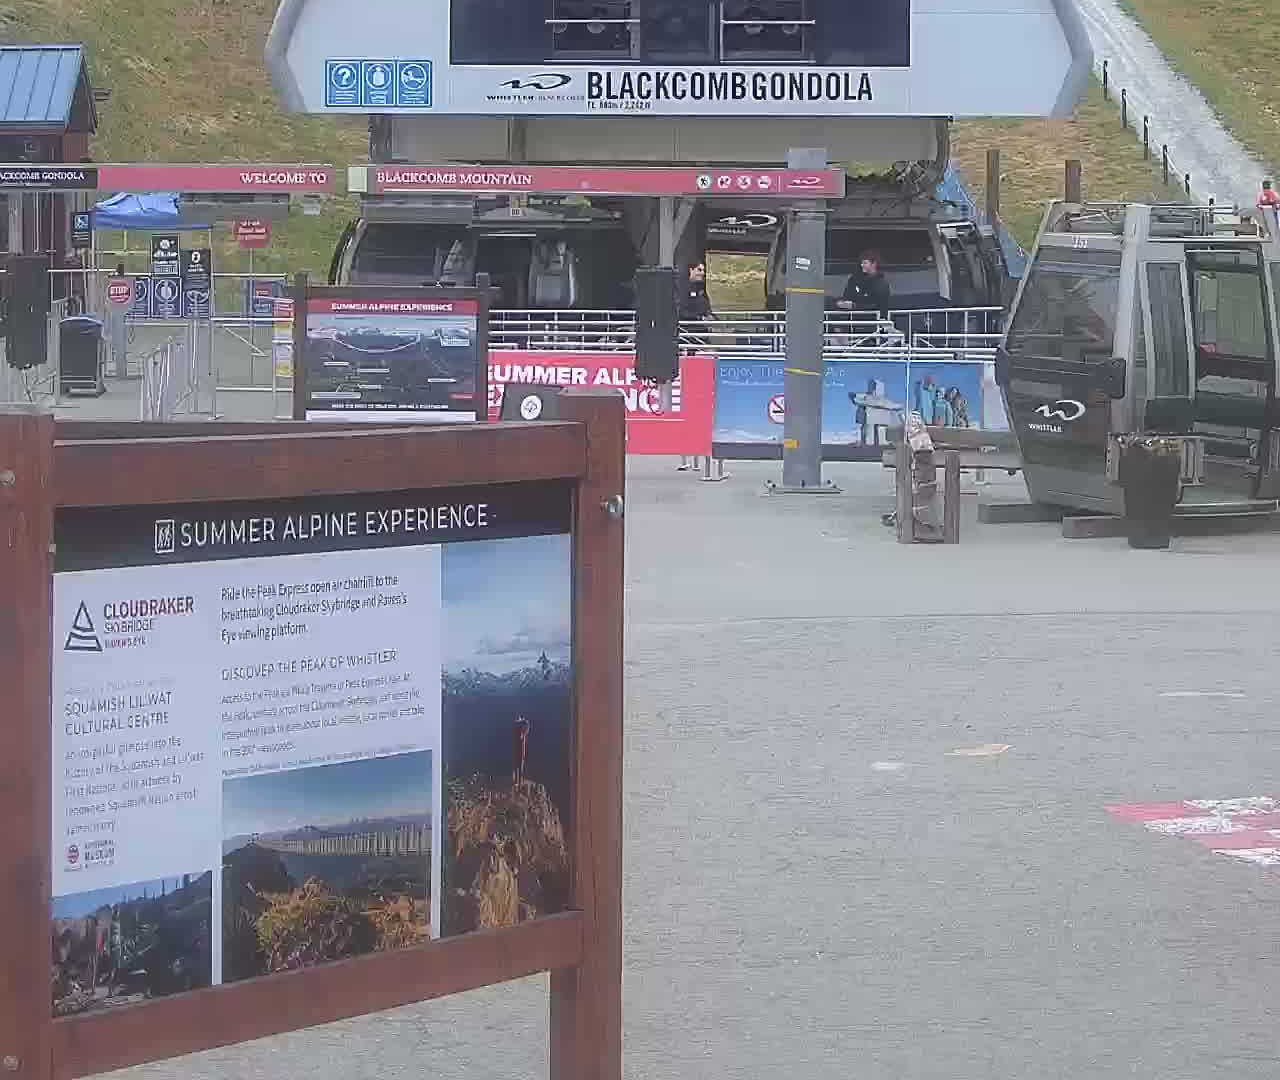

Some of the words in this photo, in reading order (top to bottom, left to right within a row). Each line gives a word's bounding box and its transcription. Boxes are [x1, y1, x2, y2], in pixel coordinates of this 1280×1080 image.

[586, 70, 747, 100] BLACKCOMB
[752, 71, 873, 101] GONDOLA
[42, 172, 84, 181] GONDOLA
[240, 172, 305, 184] WELCOME
[309, 173, 327, 184] TO
[377, 172, 456, 184] BLACKCOMB
[460, 173, 532, 185] MOUNTAIN
[180, 514, 276, 548] SUMMER
[284, 508, 358, 541] ALPINE
[365, 502, 490, 535] EXPERIENCE
[221, 586, 241, 601] Ride
[257, 584, 276, 598] Peak
[278, 582, 309, 598] Express
[310, 580, 330, 596] open
[376, 576, 384, 586] to
[384, 575, 399, 586] the
[103, 596, 195, 620] CLOUDRAKER
[221, 604, 275, 621] breathtaking
[276, 602, 320, 617] Cloudraker
[321, 596, 360, 616] Skybridge
[361, 595, 376, 607] and
[103, 619, 154, 634] SKYBRIDGE
[221, 629, 236, 644] Eye
[271, 621, 309, 639] platform.
[221, 664, 276, 681] DISCOVER
[278, 662, 297, 674] THE
[300, 658, 327, 673] PEAK
[329, 655, 344, 669] OF
[346, 649, 397, 667] WHISTLER
[65, 696, 125, 717] SQUAMISH
[65, 717, 126, 736] CULTURAL
[127, 711, 169, 729] CENTRE
